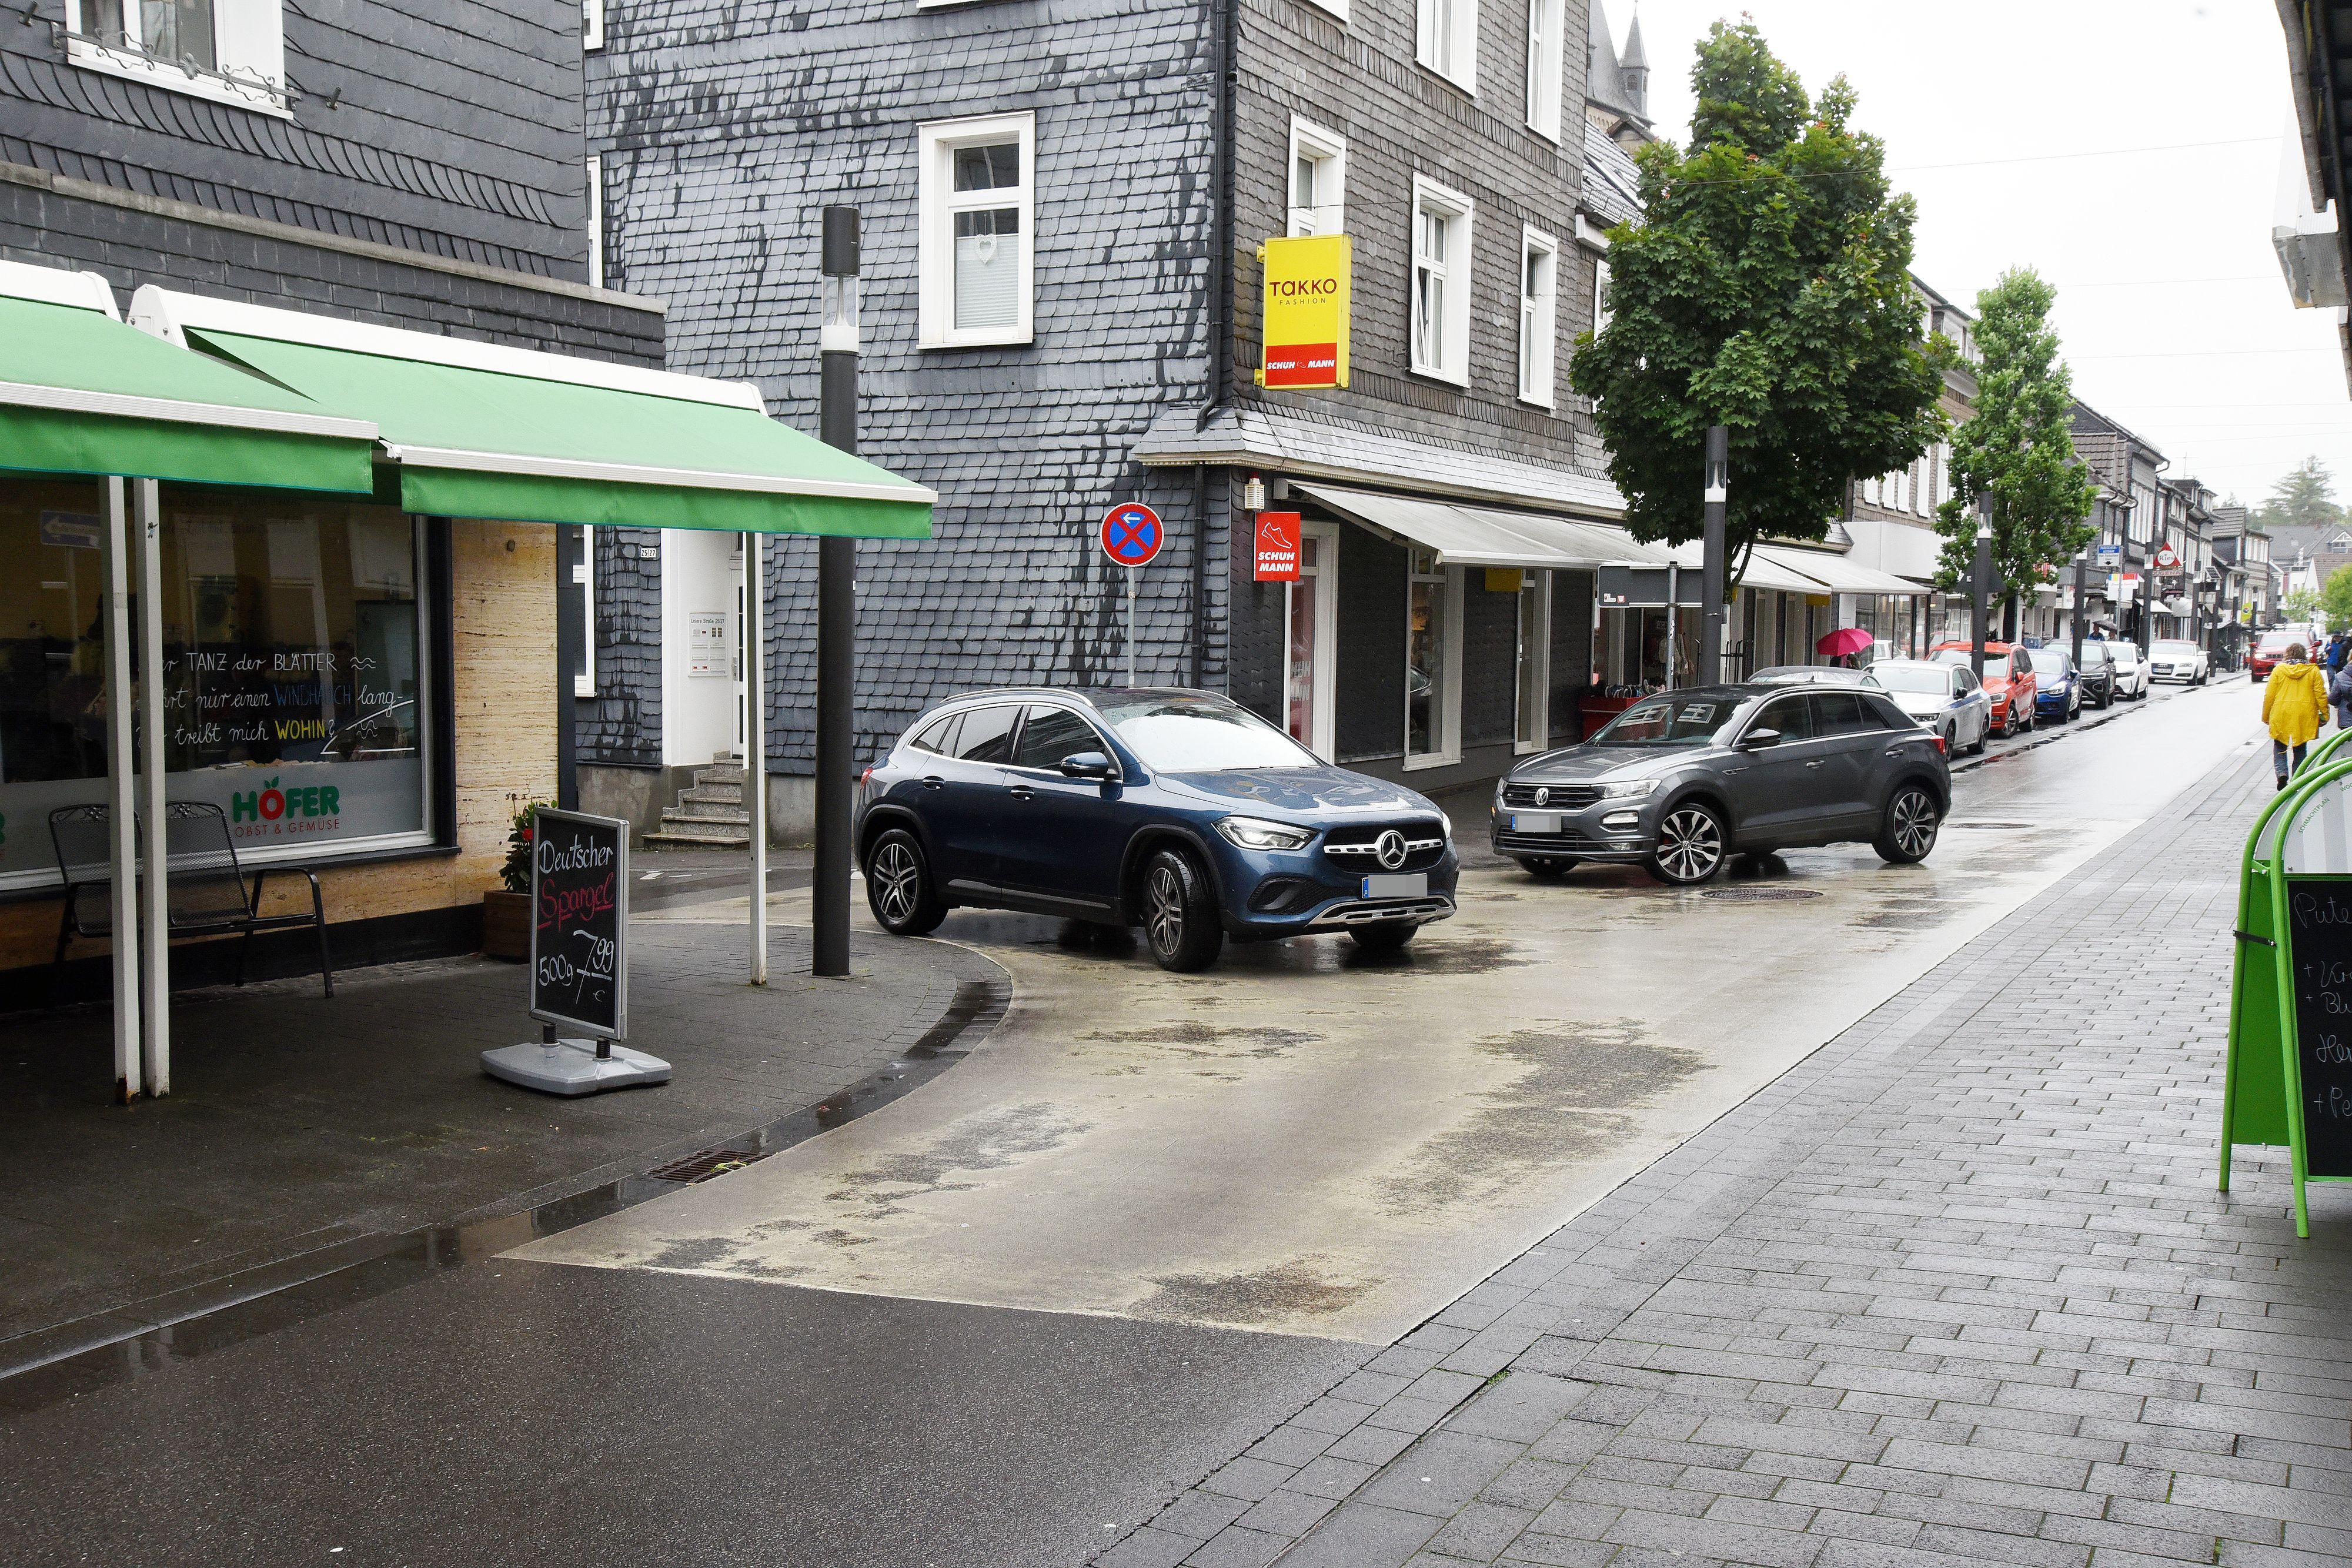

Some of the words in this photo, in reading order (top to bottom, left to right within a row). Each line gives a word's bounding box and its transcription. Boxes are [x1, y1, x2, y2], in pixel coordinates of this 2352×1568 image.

[1279, 297, 1326, 306] FASHION
[1267, 362, 1295, 370] SCHUH
[1307, 359, 1335, 368] MANN
[1258, 551, 1295, 560] SCHUH
[1259, 563, 1294, 572] MANN
[186, 652, 226, 671] TANZ
[232, 652, 266, 671] der
[274, 652, 338, 672] BLÄTTER
[230, 687, 272, 707] einen
[175, 722, 222, 745] treibt
[229, 721, 270, 743] mich
[233, 775, 340, 823] HÖFER
[2298, 797, 2331, 834] SCHMACHTPLAN
[235, 825, 268, 838] OBST
[274, 824, 282, 834] &
[288, 818, 340, 834] GEMÜSE
[539, 834, 614, 874] Deutscher
[539, 871, 614, 931] Spargel
[539, 953, 574, 987] 500g
